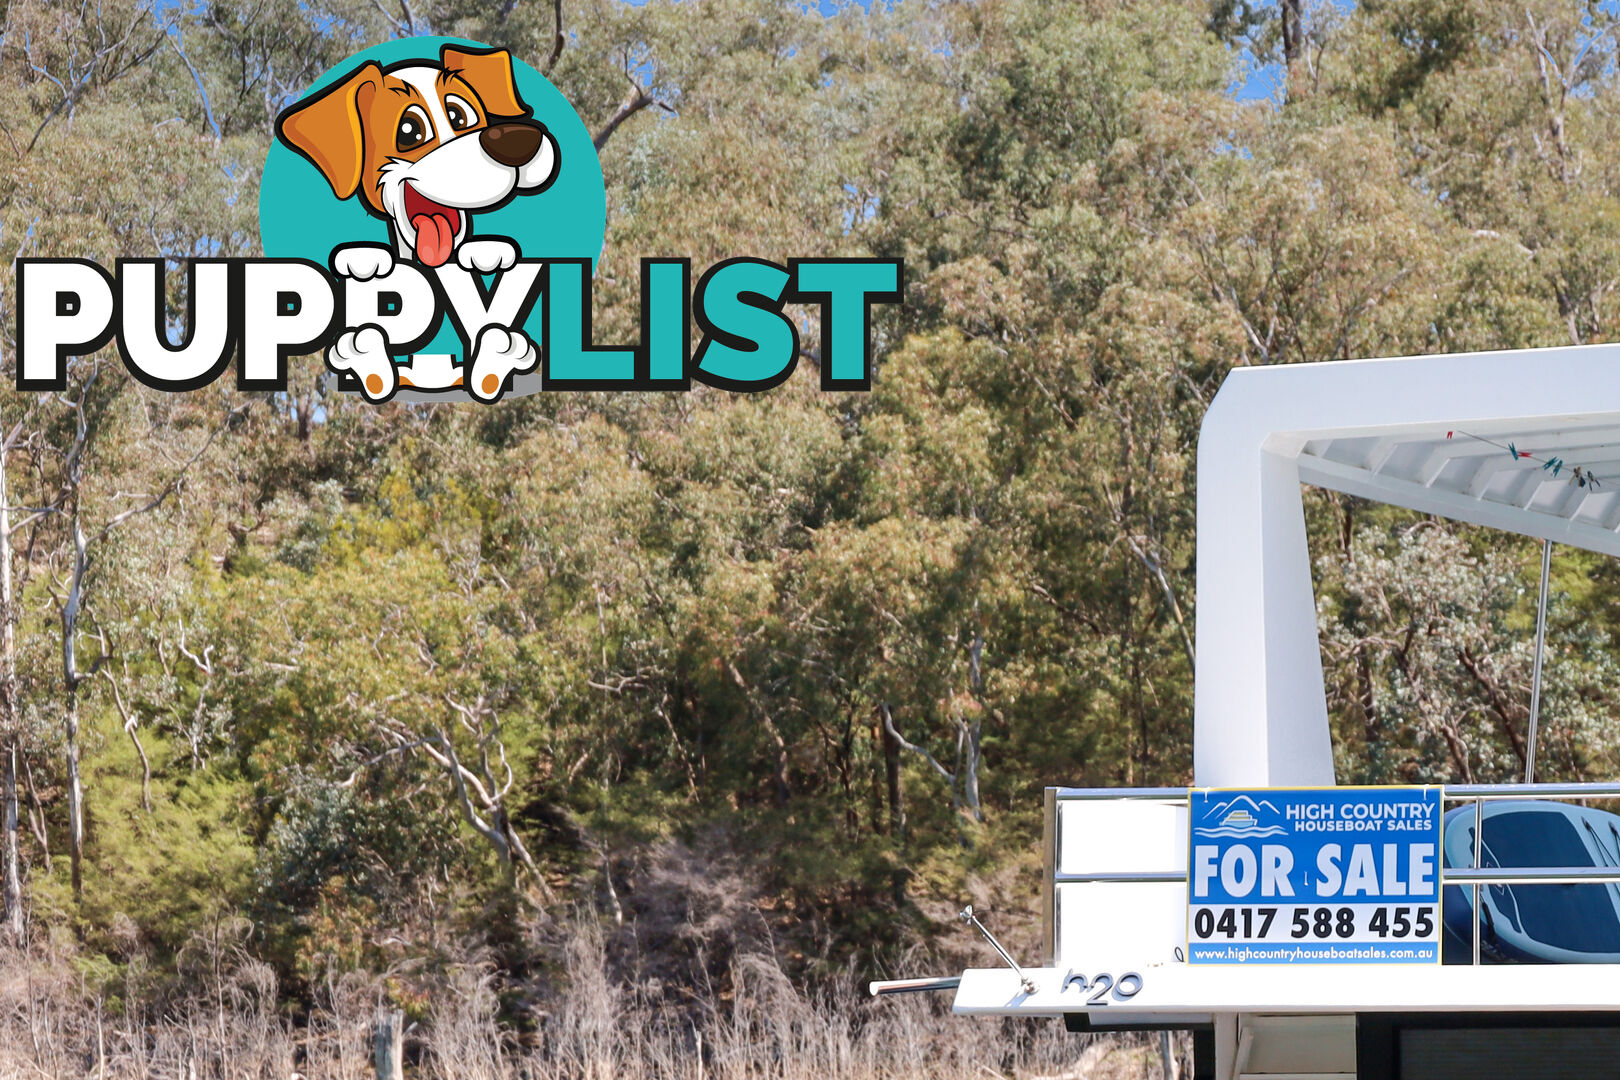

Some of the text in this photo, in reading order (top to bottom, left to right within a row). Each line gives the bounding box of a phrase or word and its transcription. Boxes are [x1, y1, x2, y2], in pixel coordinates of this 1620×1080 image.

[1286, 802, 1435, 820] HIGH COUNTRY
[1295, 819, 1432, 832] HOUSEBOAT SALES
[1194, 842, 1435, 898] FOR SALE
[1194, 906, 1434, 939] 0417 588 455
[1195, 946, 1433, 961] www.highcountryhouseboatsales.com.au
